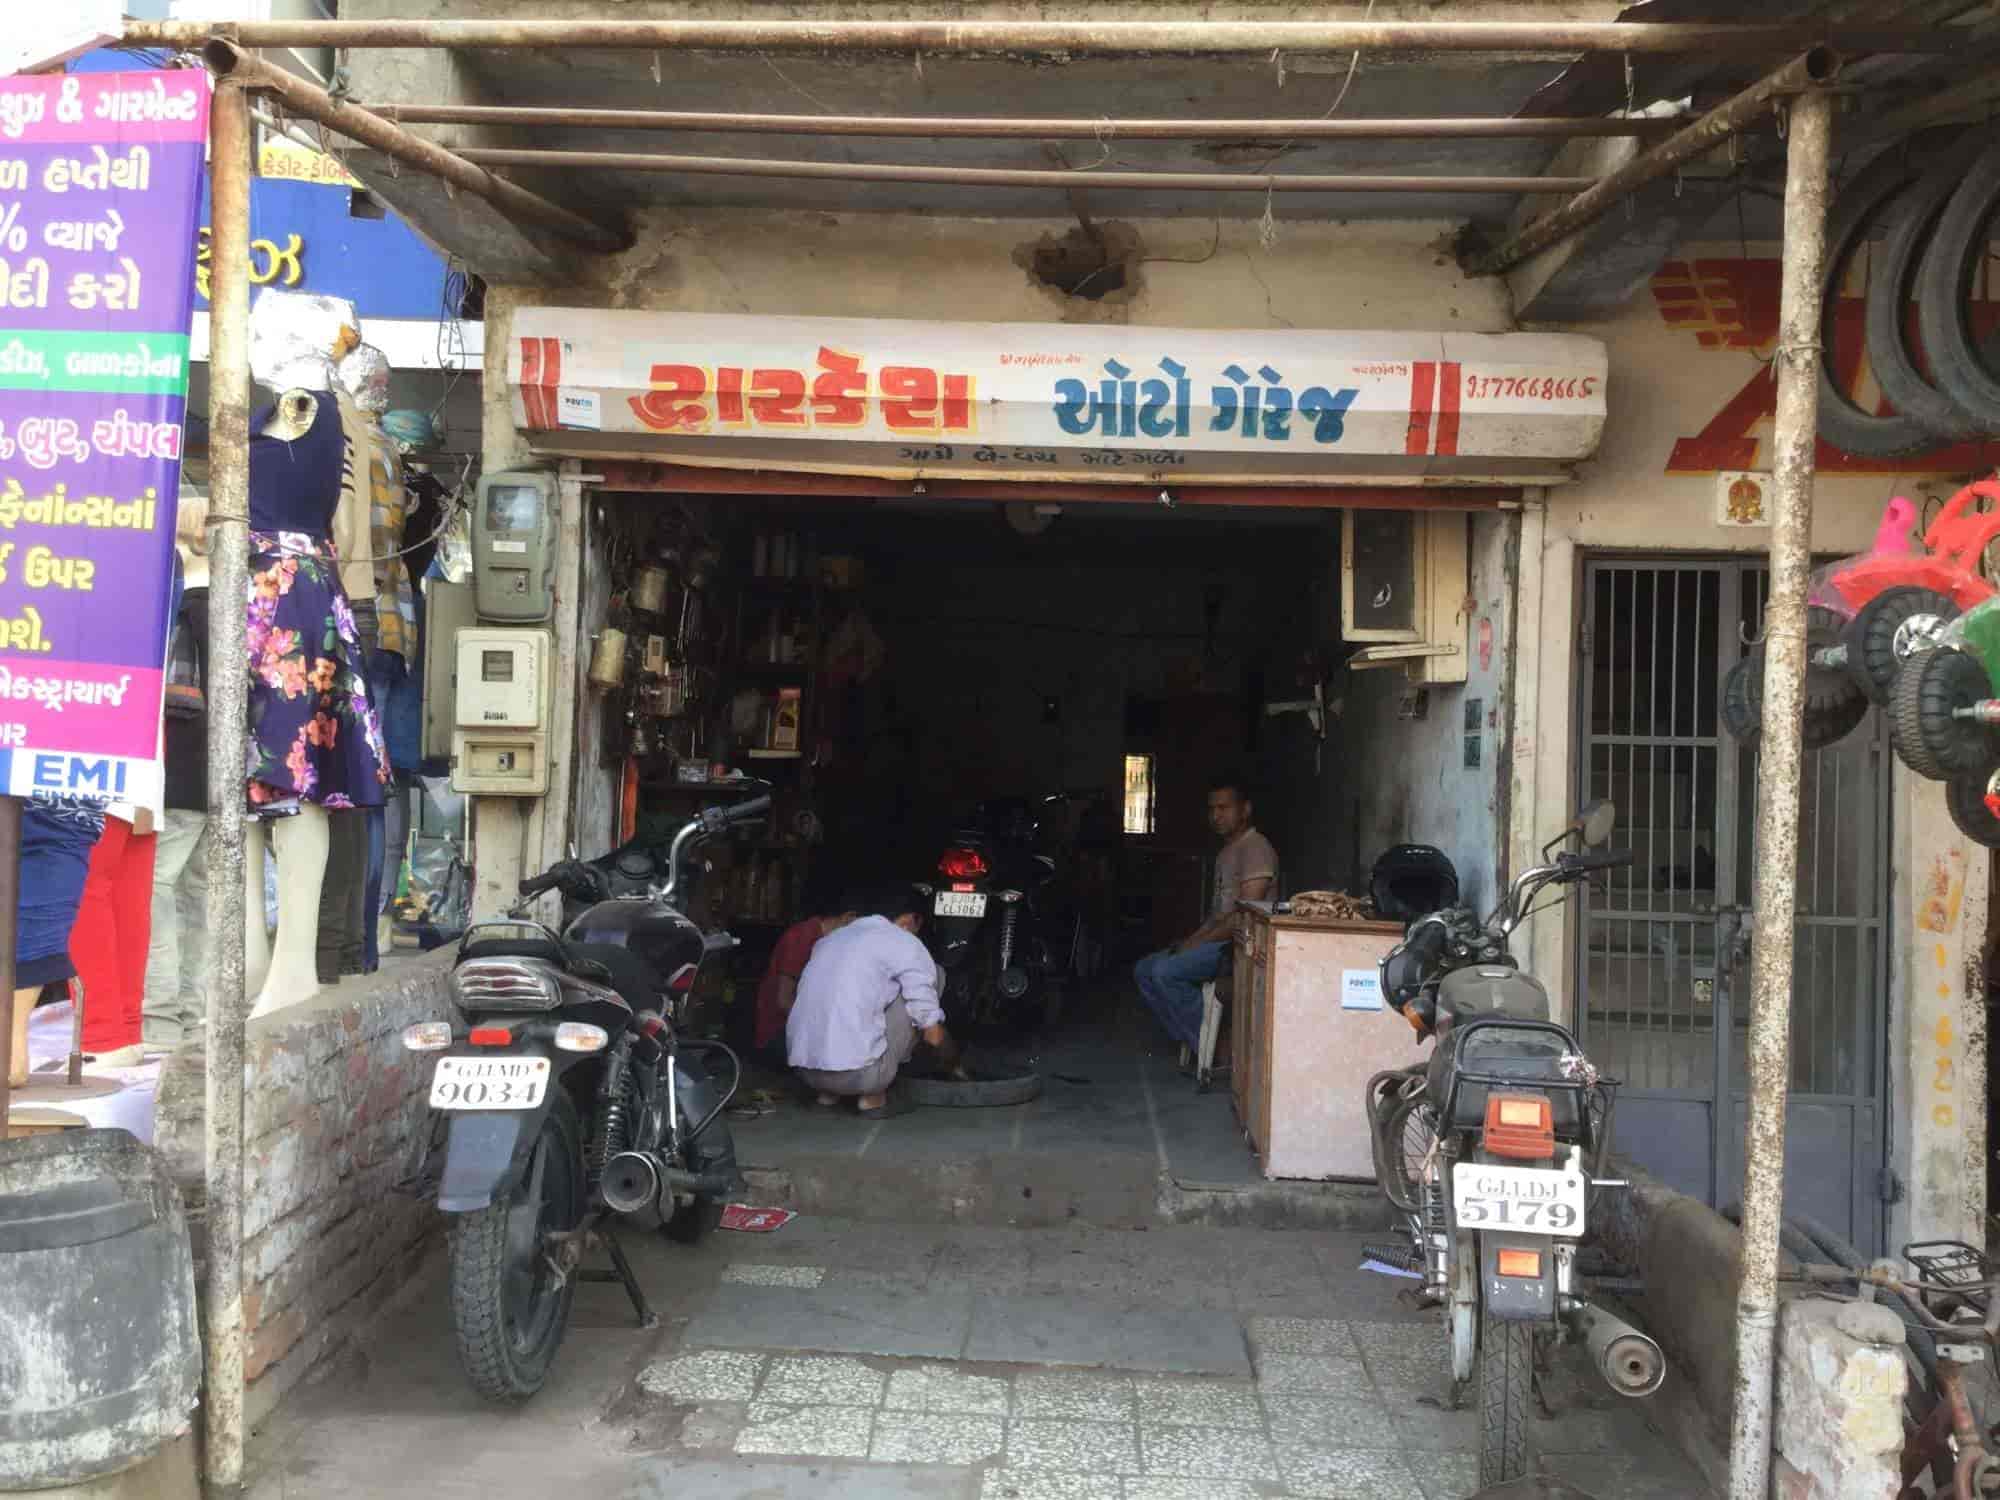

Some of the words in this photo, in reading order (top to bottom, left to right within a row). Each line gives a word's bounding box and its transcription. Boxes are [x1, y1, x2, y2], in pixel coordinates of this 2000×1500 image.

[56, 76, 83, 123] &
[43, 145, 149, 192] હપ્તેથી
[43, 209, 125, 251] વ્યાજે
[67, 257, 140, 310] કરો
[1052, 356, 1192, 438] ઓટો
[1210, 365, 1360, 444] ગેરેજ
[92, 408, 182, 461] ચંપલ
[25, 545, 95, 590] ઉપર
[33, 753, 127, 793] EMI
[438, 1082, 537, 1104] 9034
[1461, 1196, 1577, 1228] 5179
